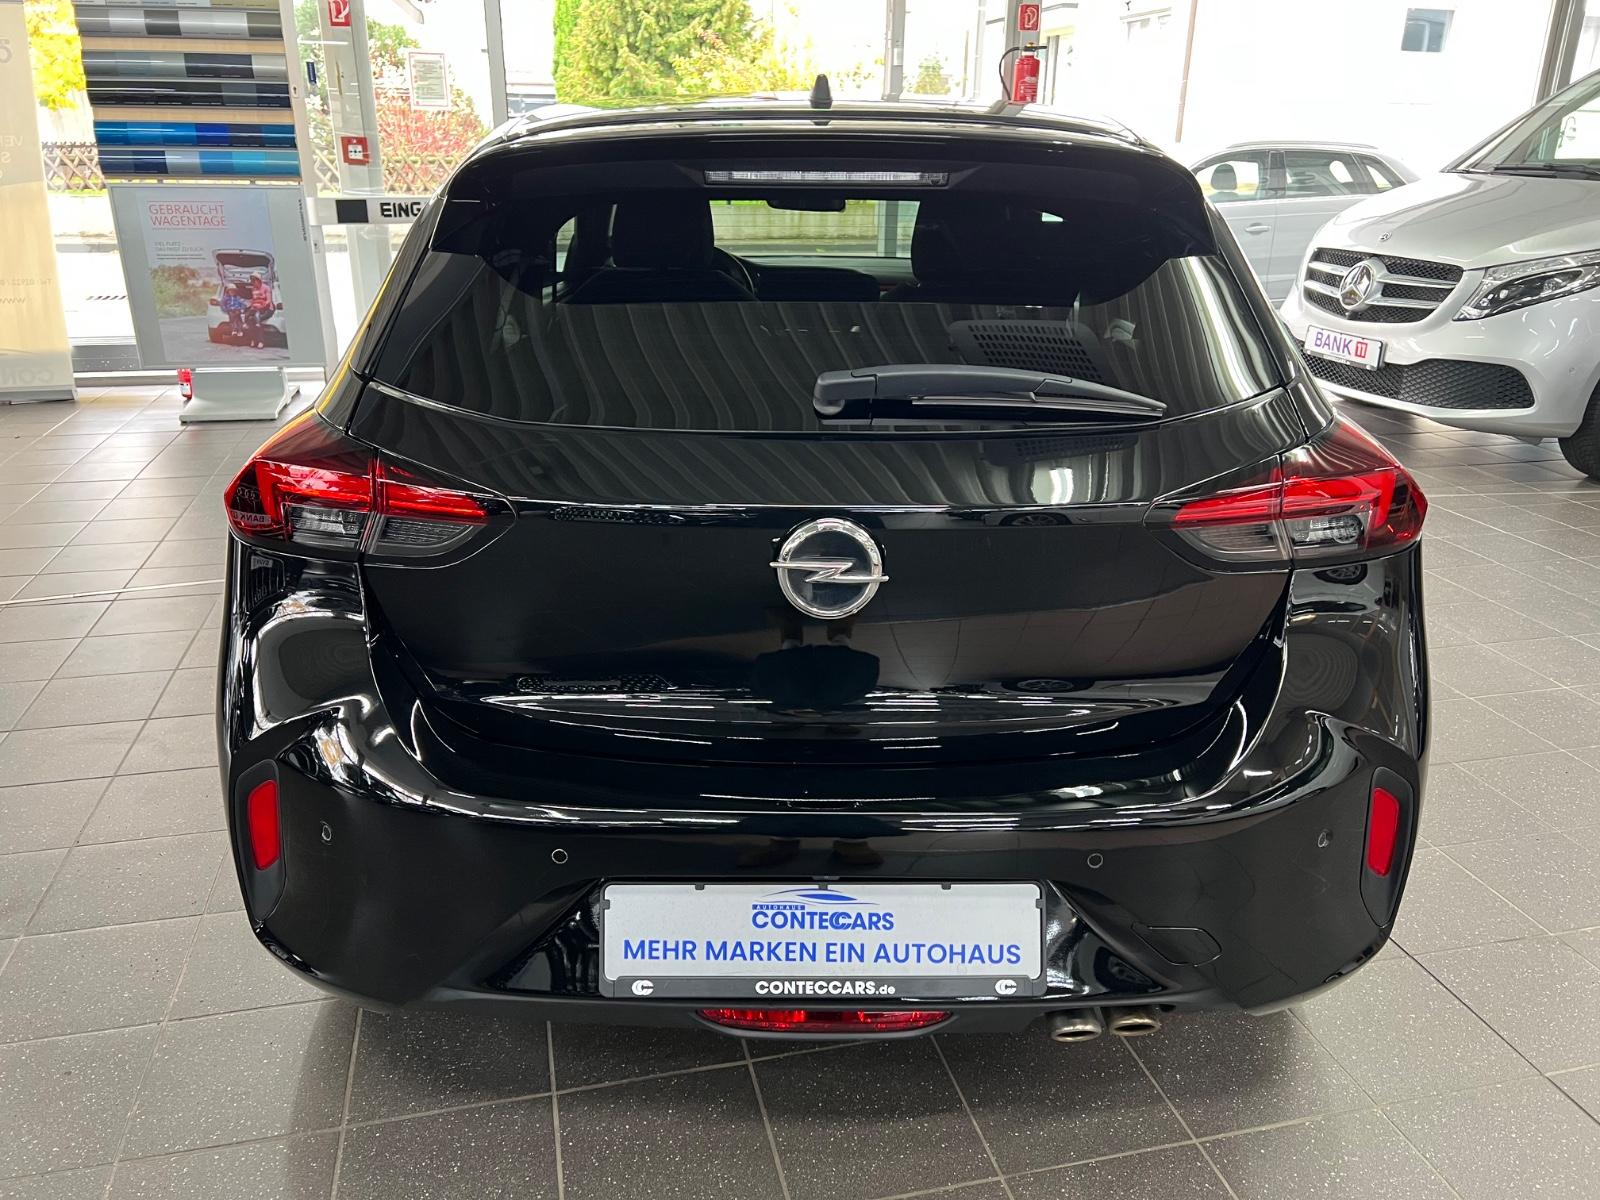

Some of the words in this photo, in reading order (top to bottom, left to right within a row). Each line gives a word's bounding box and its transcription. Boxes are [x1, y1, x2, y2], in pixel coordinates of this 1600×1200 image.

[148, 204, 225, 215] GEBRAUCHT
[380, 202, 421, 217] EING
[150, 215, 228, 227] WAGENTAGE
[1314, 331, 1352, 355] BANK
[623, 939, 697, 960] MEHR
[705, 940, 816, 962] MARKEN
[825, 942, 865, 963] EIN
[873, 943, 1021, 965] AUTOHAUS
[755, 980, 896, 995] CONTECCARS.de
